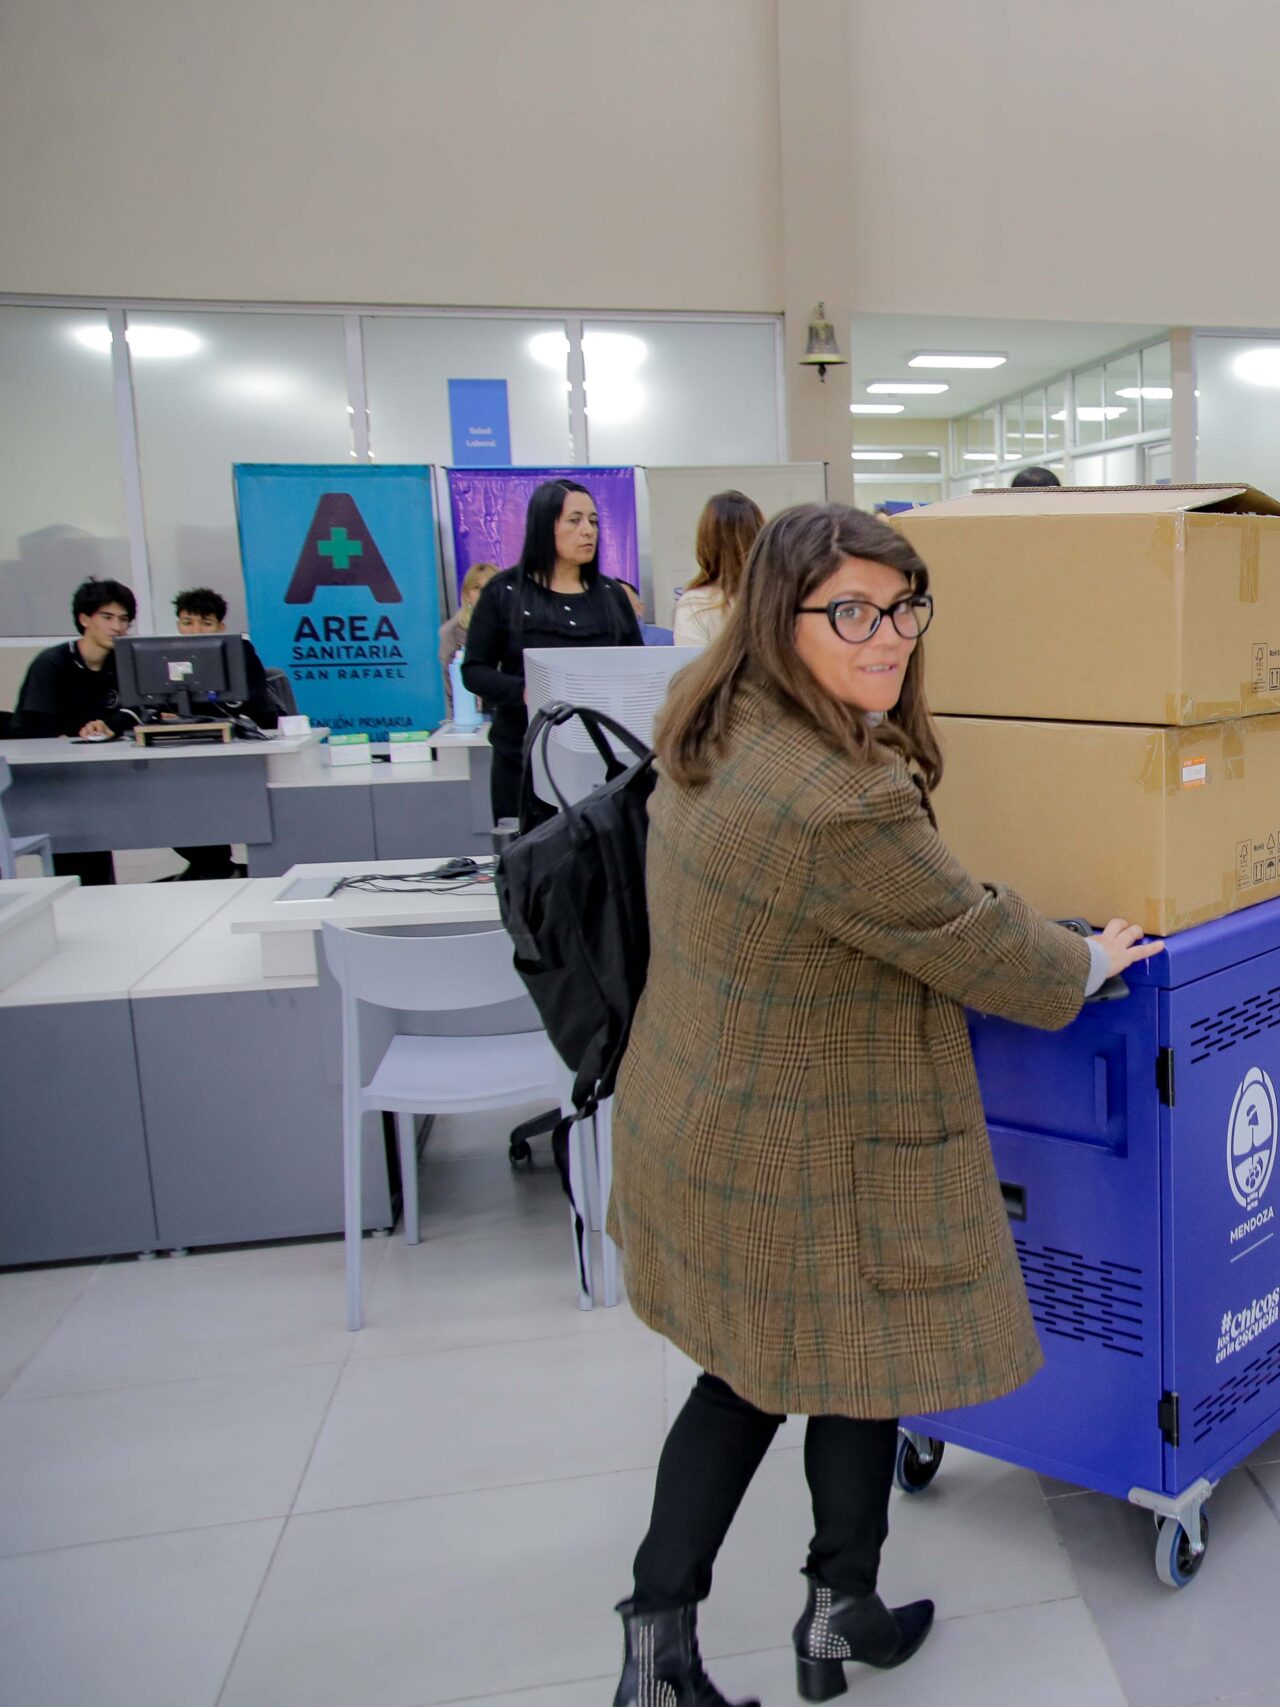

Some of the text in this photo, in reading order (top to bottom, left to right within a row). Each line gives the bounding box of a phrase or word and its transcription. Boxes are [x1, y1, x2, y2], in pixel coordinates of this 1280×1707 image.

[293, 615, 400, 642] AREA
[292, 645, 403, 661] SANITARIA
[293, 668, 405, 681] SAN RAFAEL
[1230, 1206, 1274, 1245] MENDOZA
